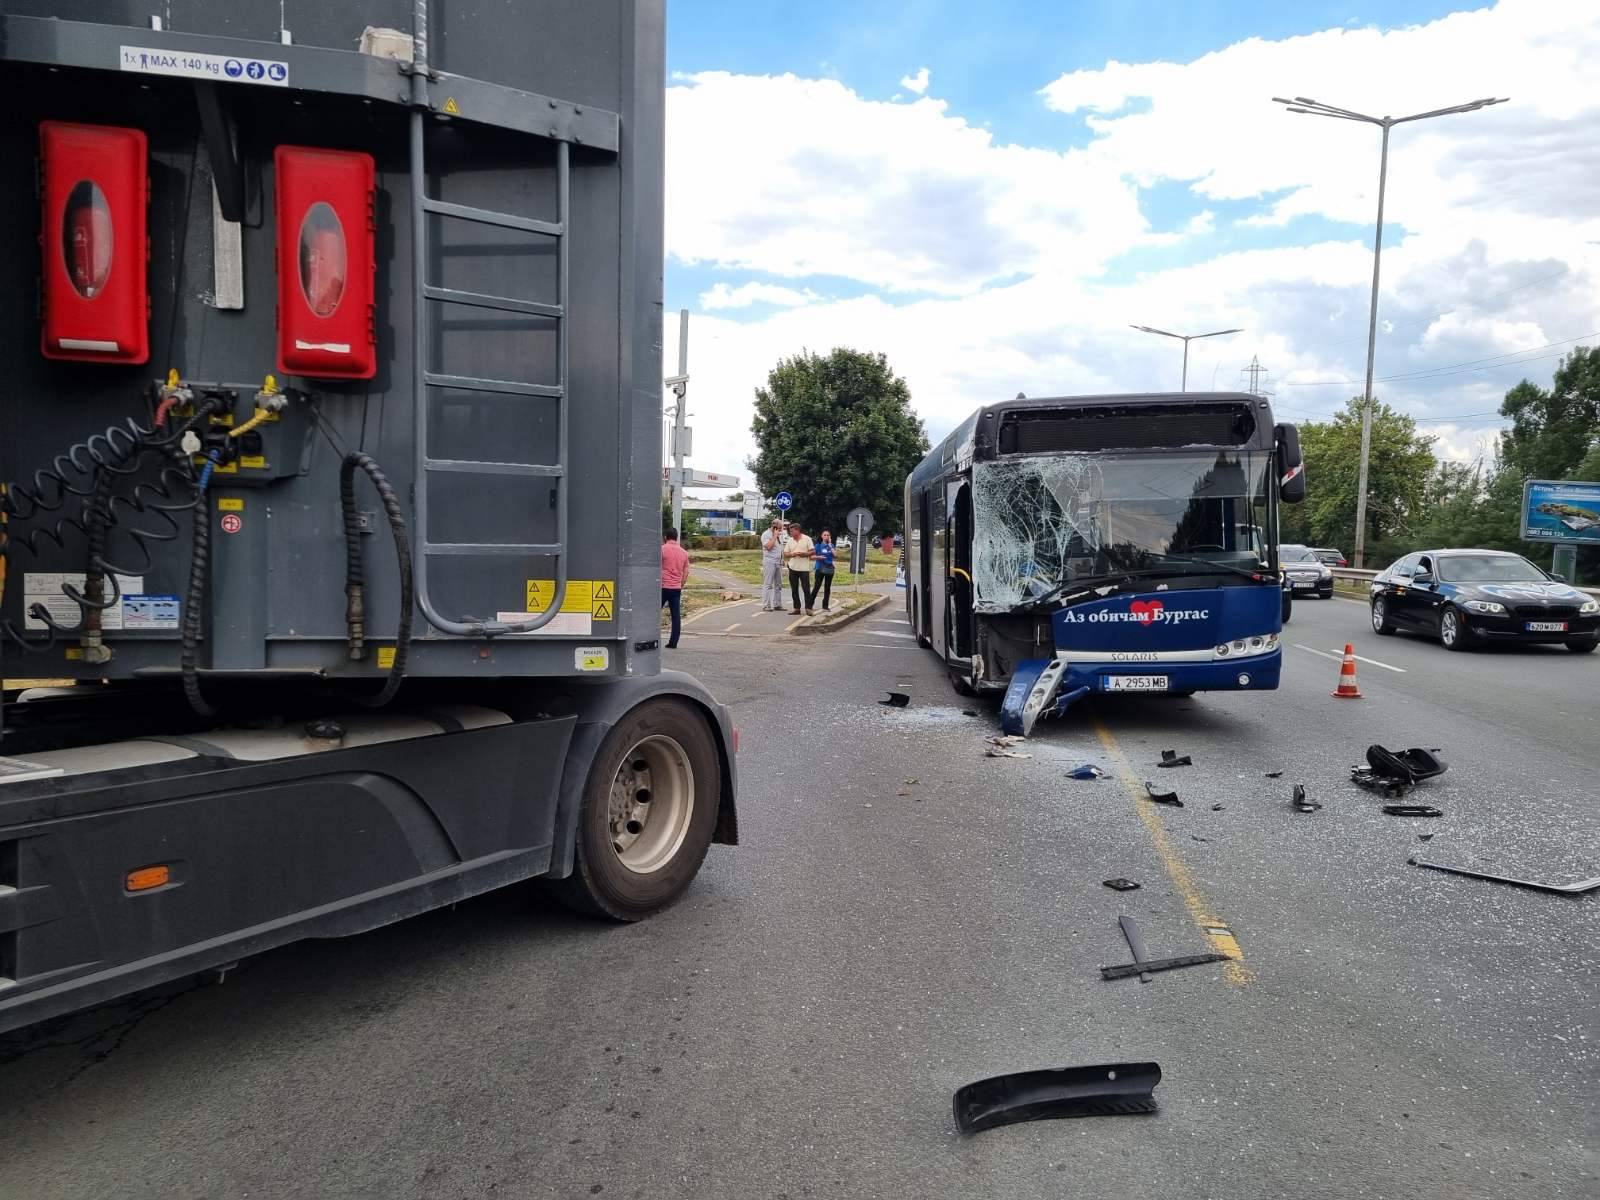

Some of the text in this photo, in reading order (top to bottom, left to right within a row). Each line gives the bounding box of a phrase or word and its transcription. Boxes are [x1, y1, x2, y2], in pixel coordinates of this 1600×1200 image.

[124, 52, 220, 74] 1x MAX 140 kg
[1063, 607, 1209, 625] Аз обичам Бургас
[1111, 653, 1159, 661] SOLARIS
